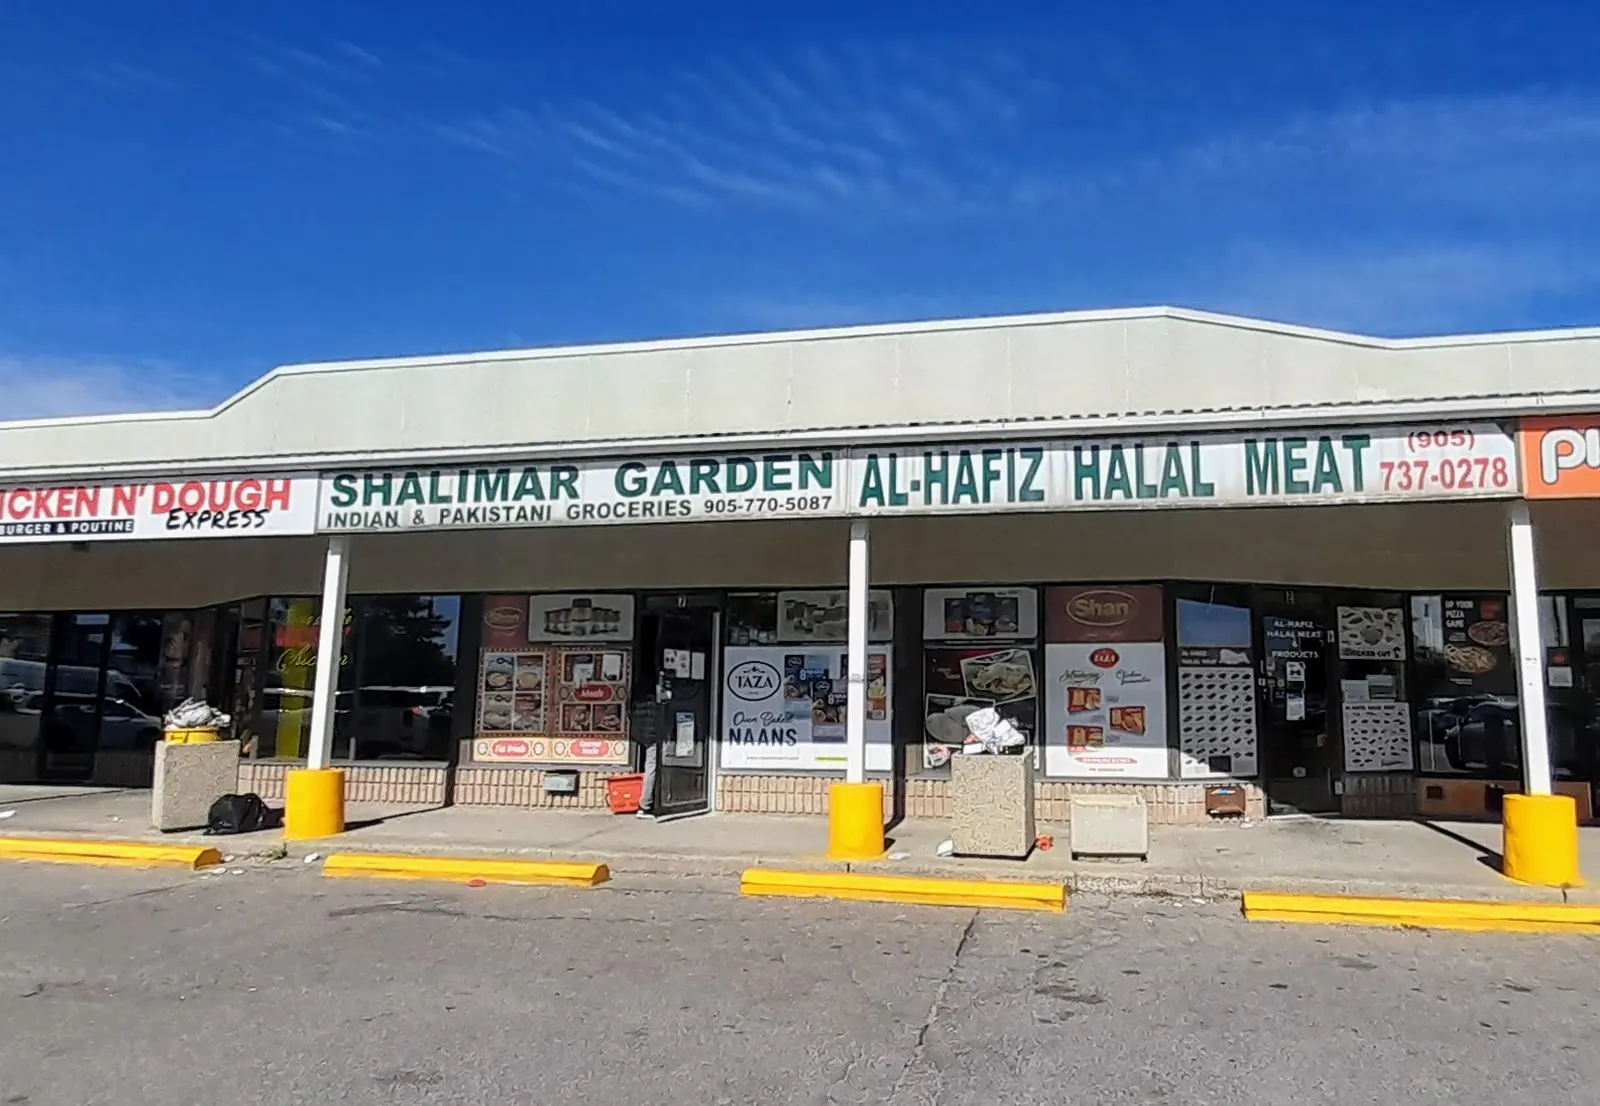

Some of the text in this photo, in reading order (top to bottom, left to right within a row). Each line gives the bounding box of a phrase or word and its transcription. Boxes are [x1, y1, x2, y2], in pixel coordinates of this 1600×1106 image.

[1407, 429, 1475, 452] (905)
[330, 451, 833, 508] SHALIMAR GARDEN
[859, 434, 1371, 507] AL-HAFIZ HALAL MEAT
[1380, 457, 1509, 491] 737-0278
[111, 483, 146, 516] N'
[151, 478, 292, 515] DOUGH
[166, 507, 270, 531] EXPRESS
[327, 496, 832, 528] INDIAN & PAKISTANI GROCERIES 905-770-5087
[57, 524, 66, 534] &
[71, 520, 133, 533] POUTINE
[1075, 599, 1130, 617] Shan
[1271, 650, 1320, 659] PRODUCTS
[735, 675, 774, 689] TAZA
[729, 727, 798, 746] NAANS
